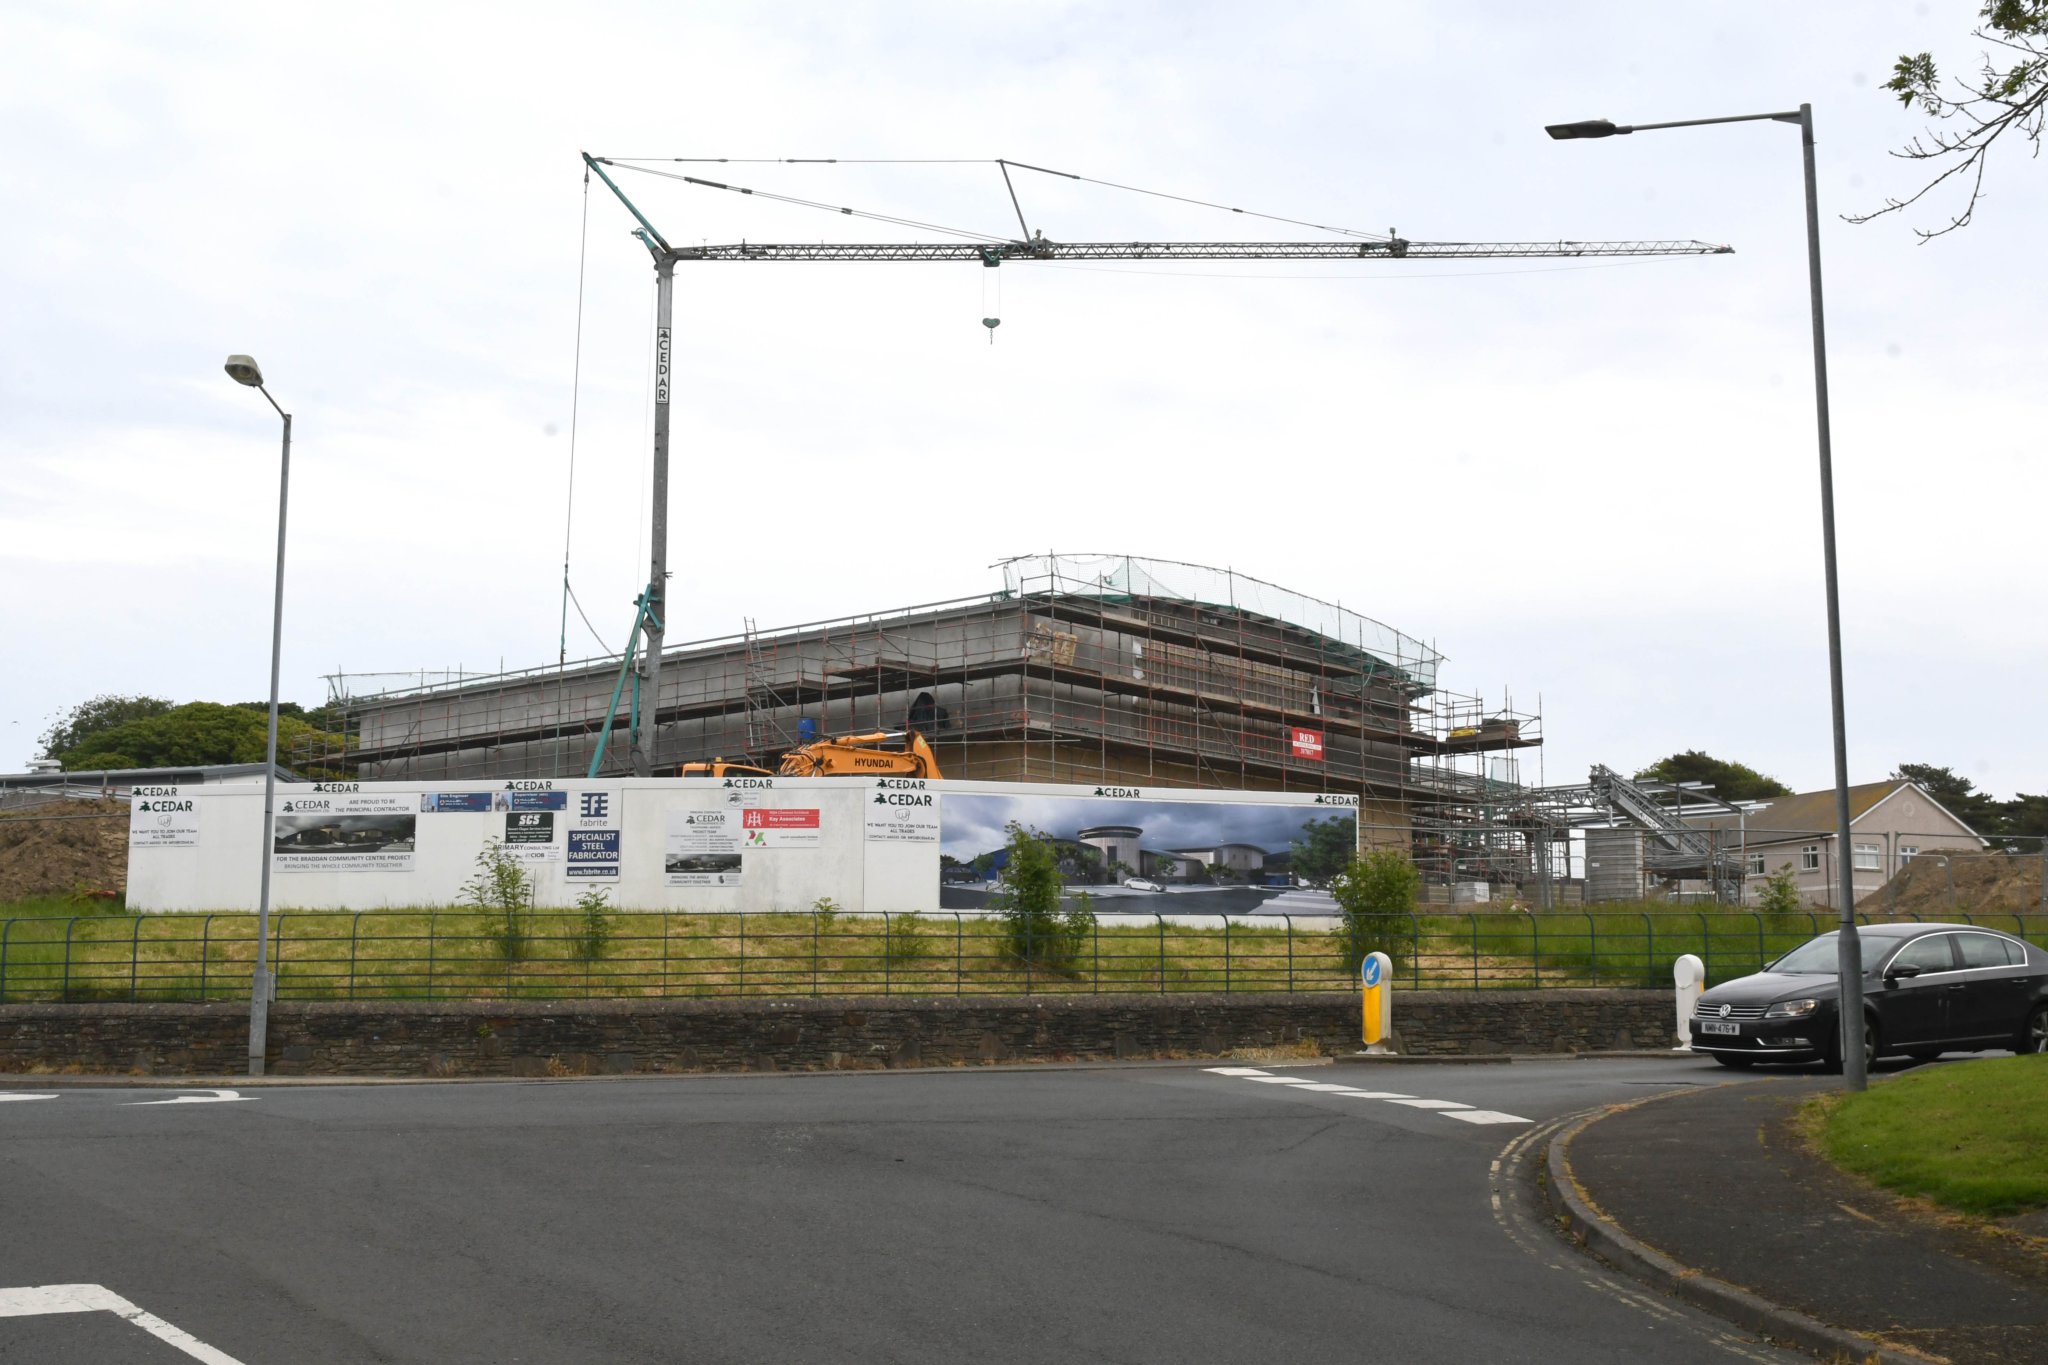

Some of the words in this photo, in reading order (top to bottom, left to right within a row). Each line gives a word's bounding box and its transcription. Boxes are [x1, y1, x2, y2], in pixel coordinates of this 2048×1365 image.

[658, 340, 668, 400] CEDAR
[1299, 732, 1315, 743] RED
[854, 757, 894, 768] HYUNDAI
[323, 783, 360, 792] CEDAR
[515, 781, 552, 790] CEDAR
[734, 779, 773, 788] CEDAR
[887, 779, 926, 790] CEDAR
[142, 787, 178, 796] CEDAR
[1104, 788, 1140, 798] CEDAR
[295, 800, 330, 809] CEDAR
[888, 794, 932, 806] CEDAR
[1324, 795, 1359, 806] CEDAR
[152, 800, 193, 812] CEDAR
[518, 814, 541, 825] SCS
[580, 819, 608, 827] fabrite
[572, 833, 616, 841] SPECIALIST
[582, 842, 605, 850] STEEL
[568, 851, 618, 860] FABRICATOR
[568, 867, 617, 875] www.fabrite.co.uk
